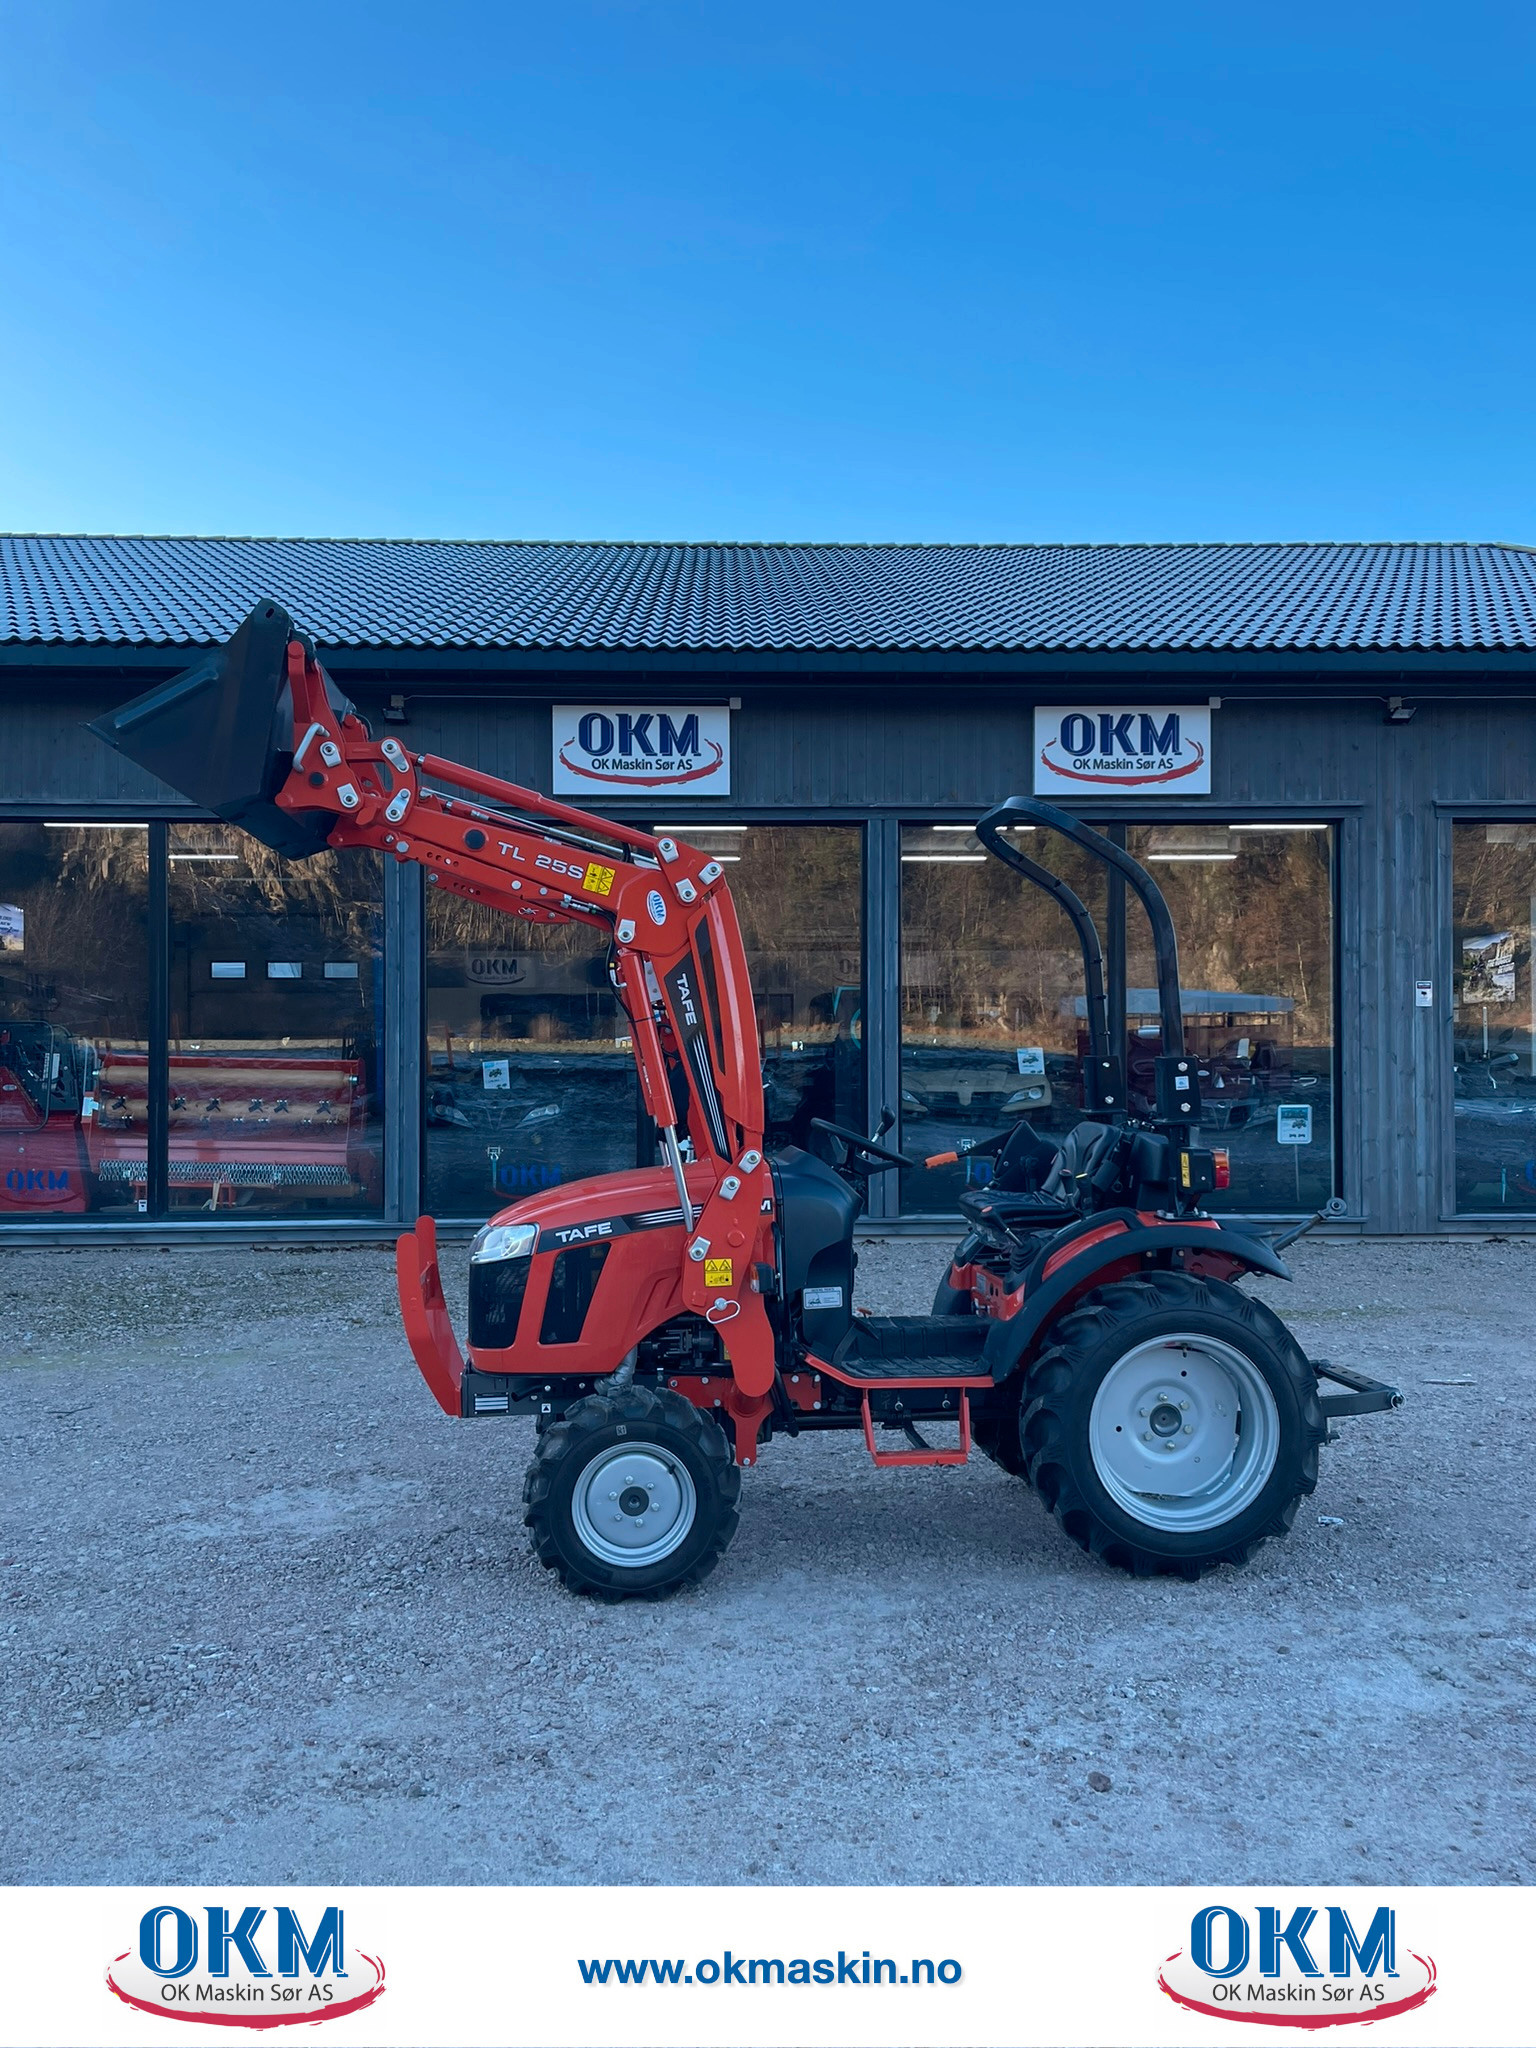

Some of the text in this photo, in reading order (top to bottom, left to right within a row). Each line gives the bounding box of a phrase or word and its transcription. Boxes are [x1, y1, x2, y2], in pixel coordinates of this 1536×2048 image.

[578, 712, 701, 757] OKM
[1060, 713, 1182, 756] OKM
[591, 757, 693, 770] OK Maskin Sør AS
[1072, 757, 1174, 770] OK Maskin Sør AS
[498, 841, 584, 879] TL 25S
[471, 958, 518, 975] OKM
[676, 973, 698, 1026] TAFE
[6, 1168, 69, 1191] OKM
[500, 1164, 561, 1187] OKM
[555, 1221, 613, 1243] TAFE
